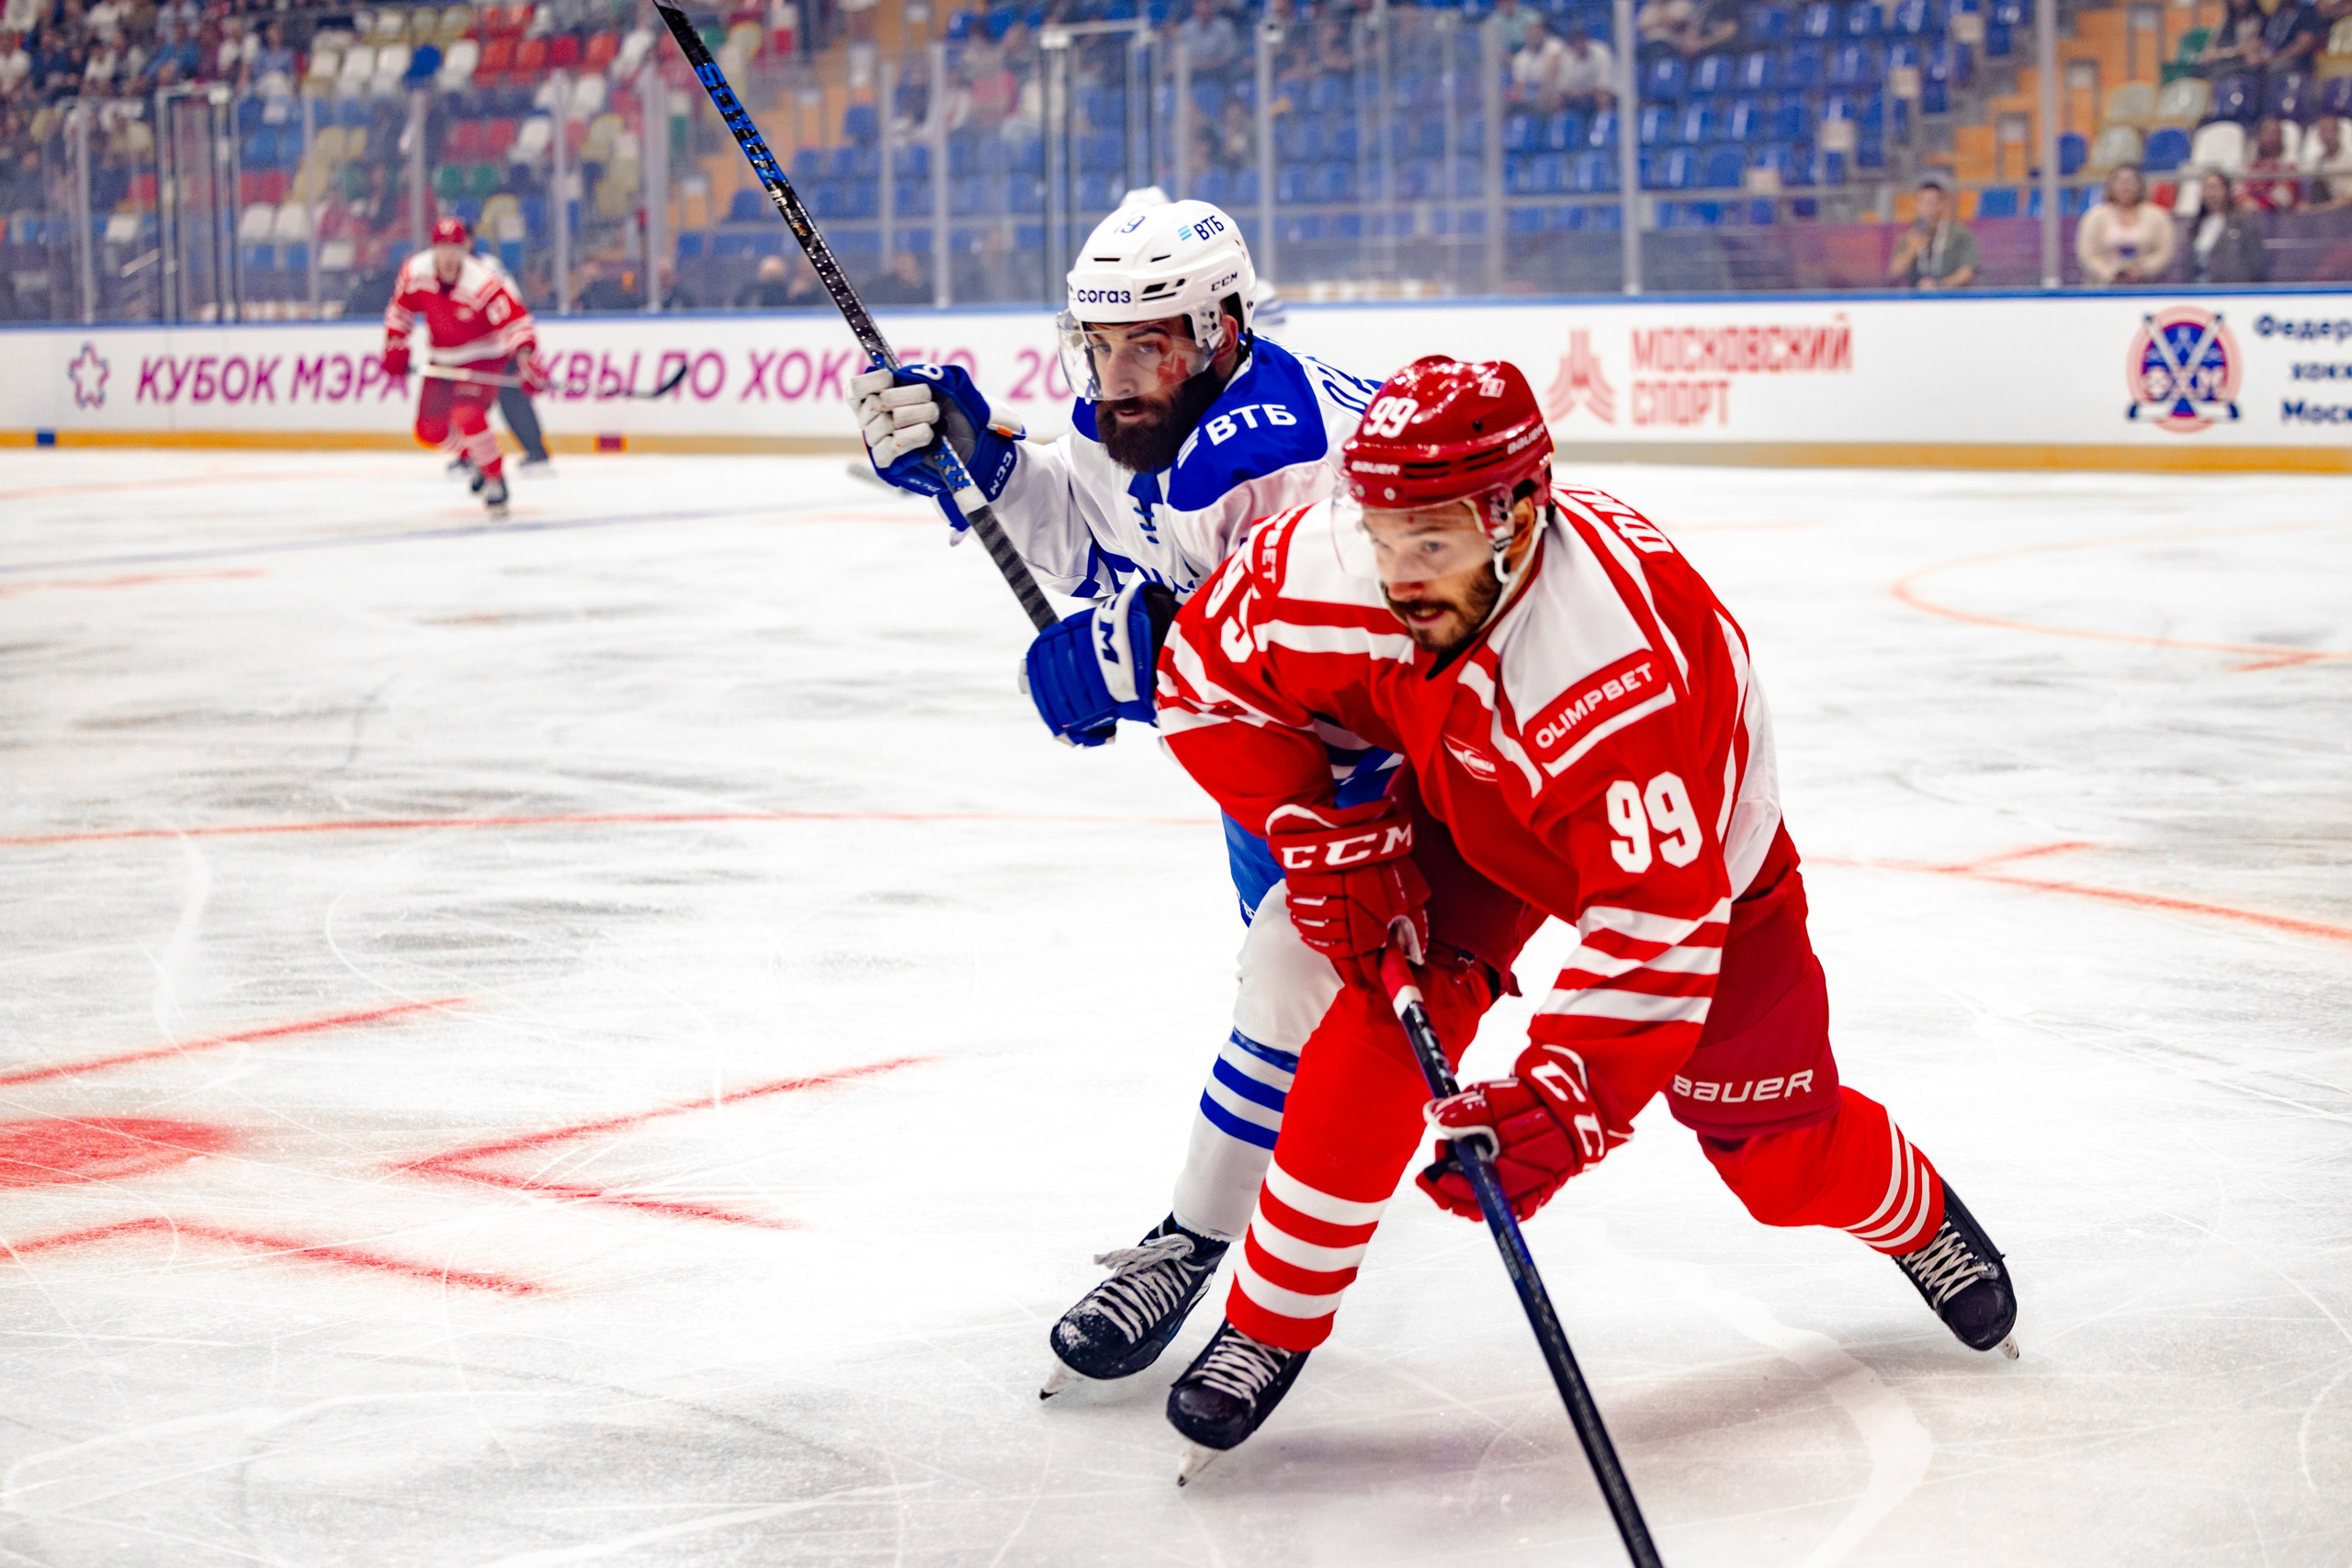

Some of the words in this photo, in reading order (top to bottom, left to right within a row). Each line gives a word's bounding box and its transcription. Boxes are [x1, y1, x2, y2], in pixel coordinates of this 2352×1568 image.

[695, 62, 788, 187] SOYUZ
[1193, 216, 1225, 241] ВТБ
[1077, 289, 1131, 304] согаз
[1212, 272, 1238, 292] CCM
[136, 355, 280, 402] КУБОК
[655, 348, 726, 401] ПО
[1204, 404, 1296, 446] ВТБ
[1363, 396, 1419, 438] 99
[1535, 661, 1653, 749] OLIMPBET
[1606, 772, 1702, 873] 99
[1281, 823, 1412, 869] CCM
[1531, 1060, 1605, 1170] CC
